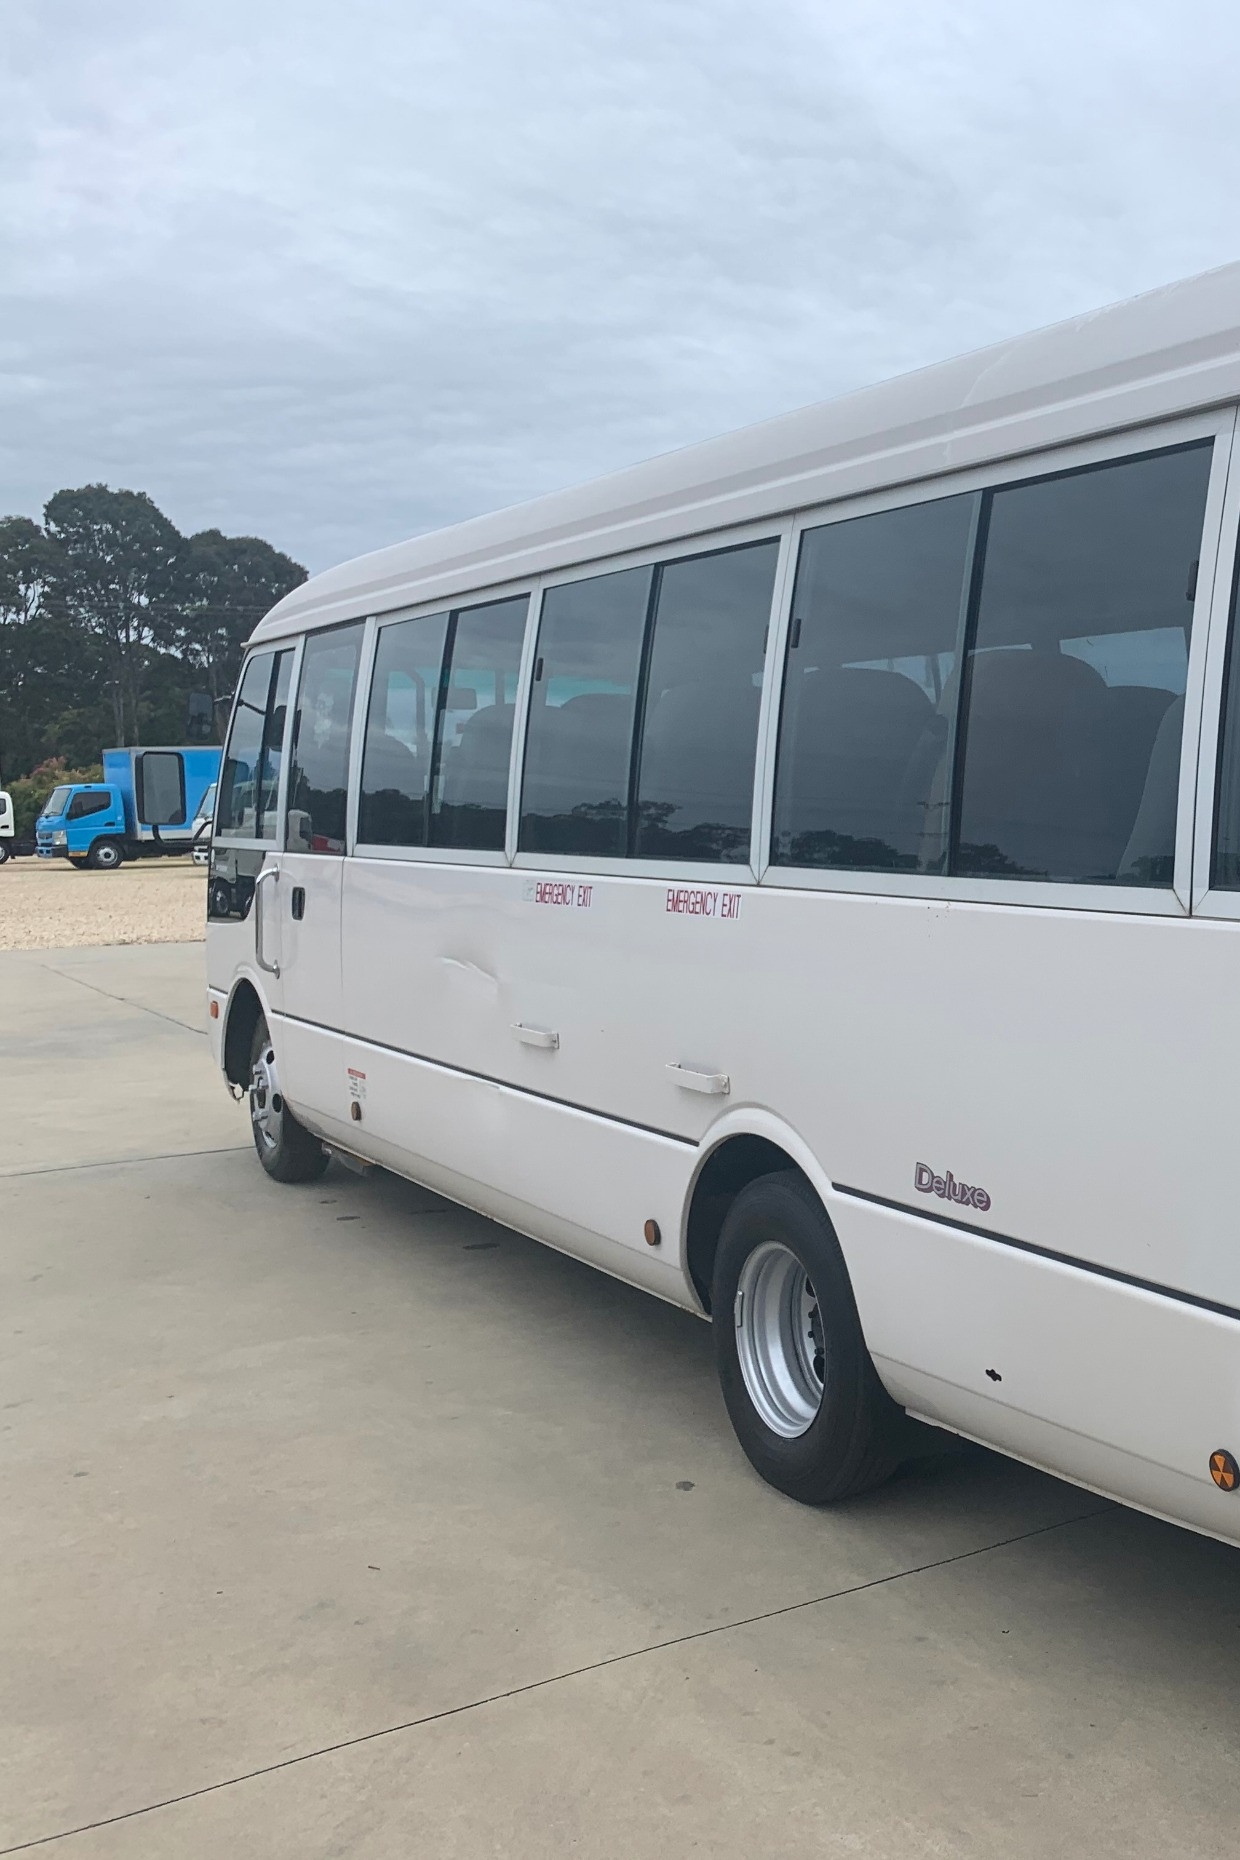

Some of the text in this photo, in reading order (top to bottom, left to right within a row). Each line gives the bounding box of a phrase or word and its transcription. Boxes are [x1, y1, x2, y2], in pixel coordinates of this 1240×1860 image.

[535, 882, 593, 908] EMERGENCY EXIT
[665, 888, 742, 919] EMERGENCY EXIT
[914, 1161, 992, 1212] Deluxe
